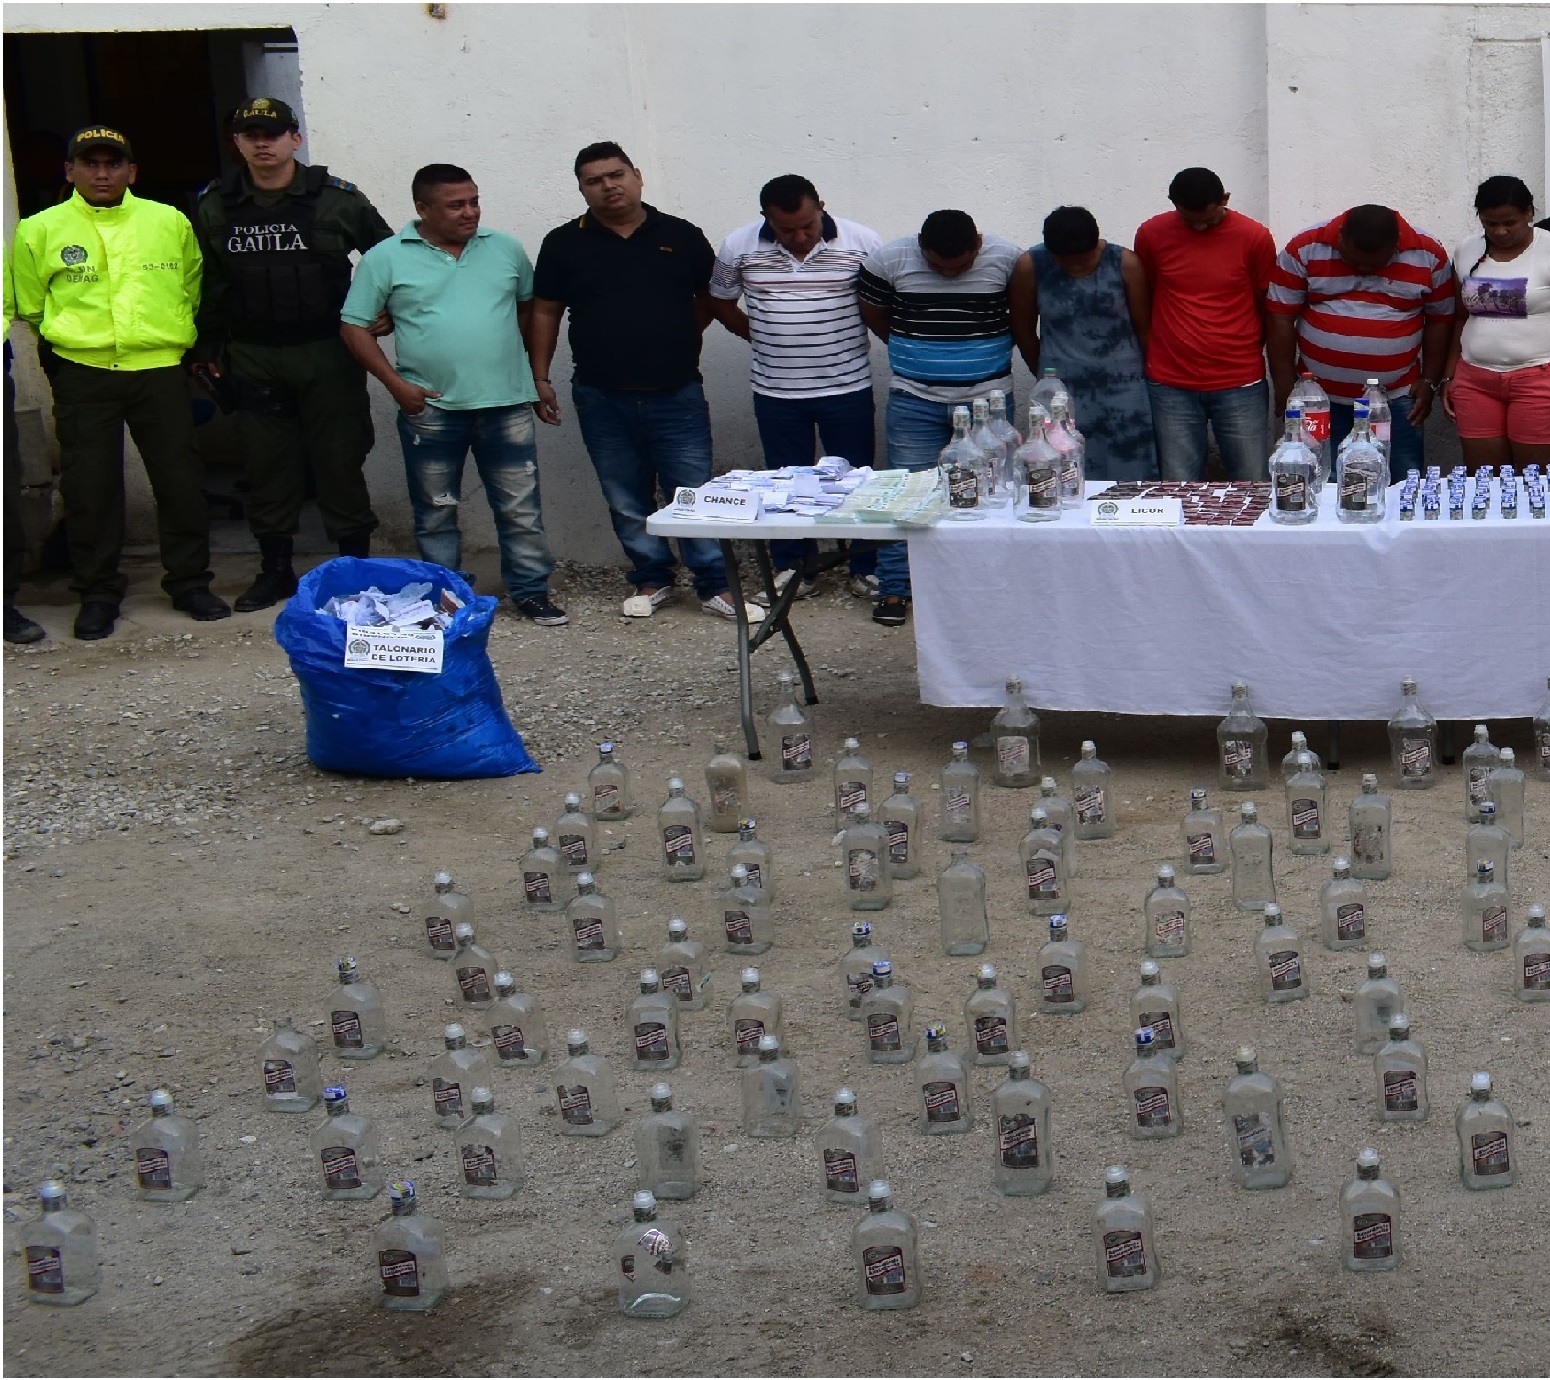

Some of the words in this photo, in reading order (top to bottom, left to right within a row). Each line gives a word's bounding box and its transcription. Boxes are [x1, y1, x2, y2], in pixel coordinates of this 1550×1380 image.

[77, 129, 125, 144] POLICIA
[233, 223, 299, 235] POLICIA
[228, 233, 308, 253] GAULA
[703, 495, 747, 506] CHANCE
[373, 644, 436, 654] TALONARIO
[371, 653, 386, 661] DE
